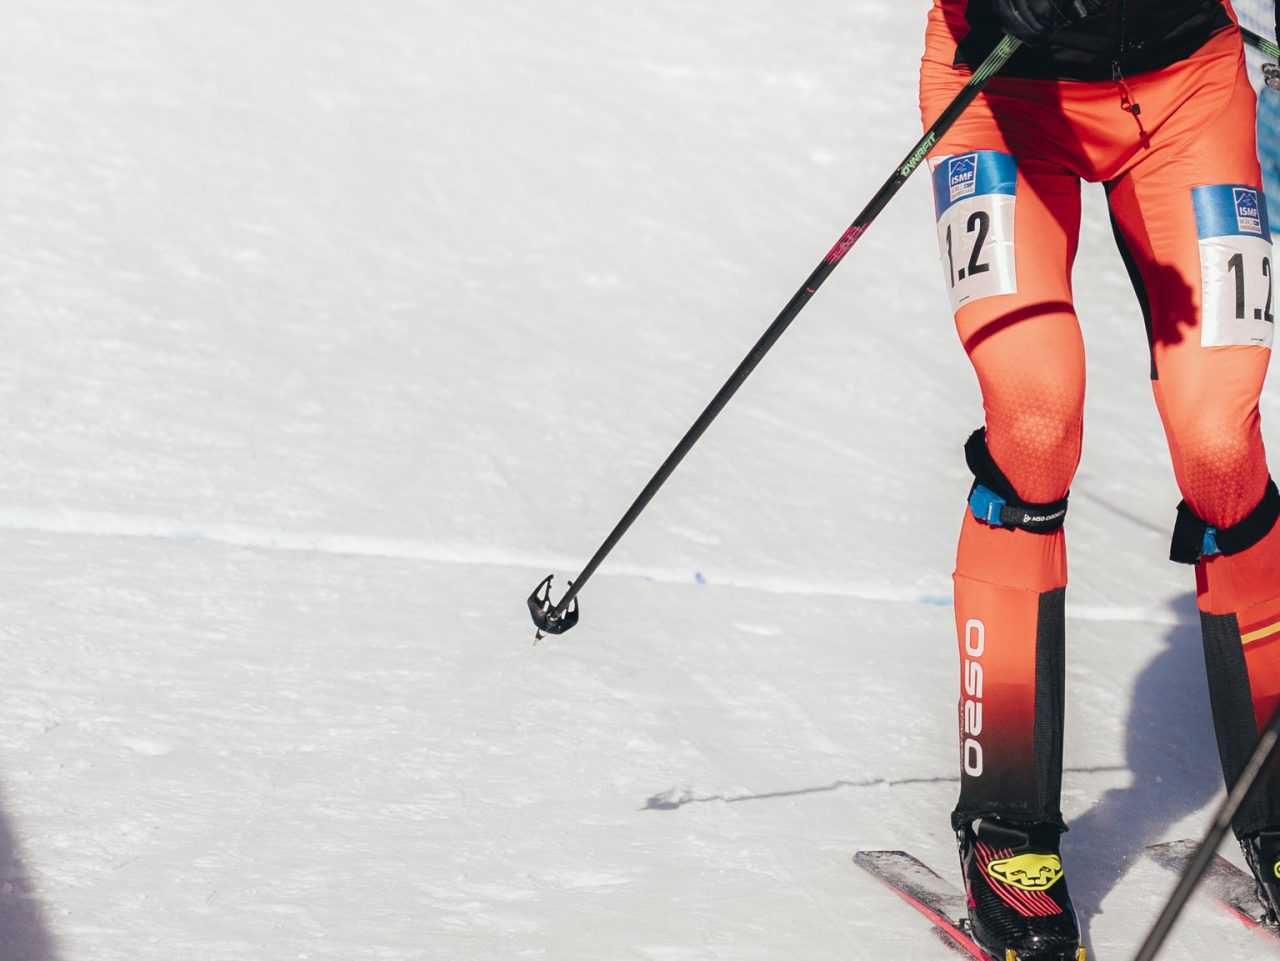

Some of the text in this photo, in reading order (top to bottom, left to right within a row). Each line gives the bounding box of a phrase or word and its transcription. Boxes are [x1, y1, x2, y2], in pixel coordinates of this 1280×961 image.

[900, 130, 938, 178] DYNAFIT
[951, 171, 973, 186] ISMF
[1239, 206, 1258, 218] ISMF
[944, 211, 990, 289] 1.2
[1227, 253, 1274, 324] 1.2
